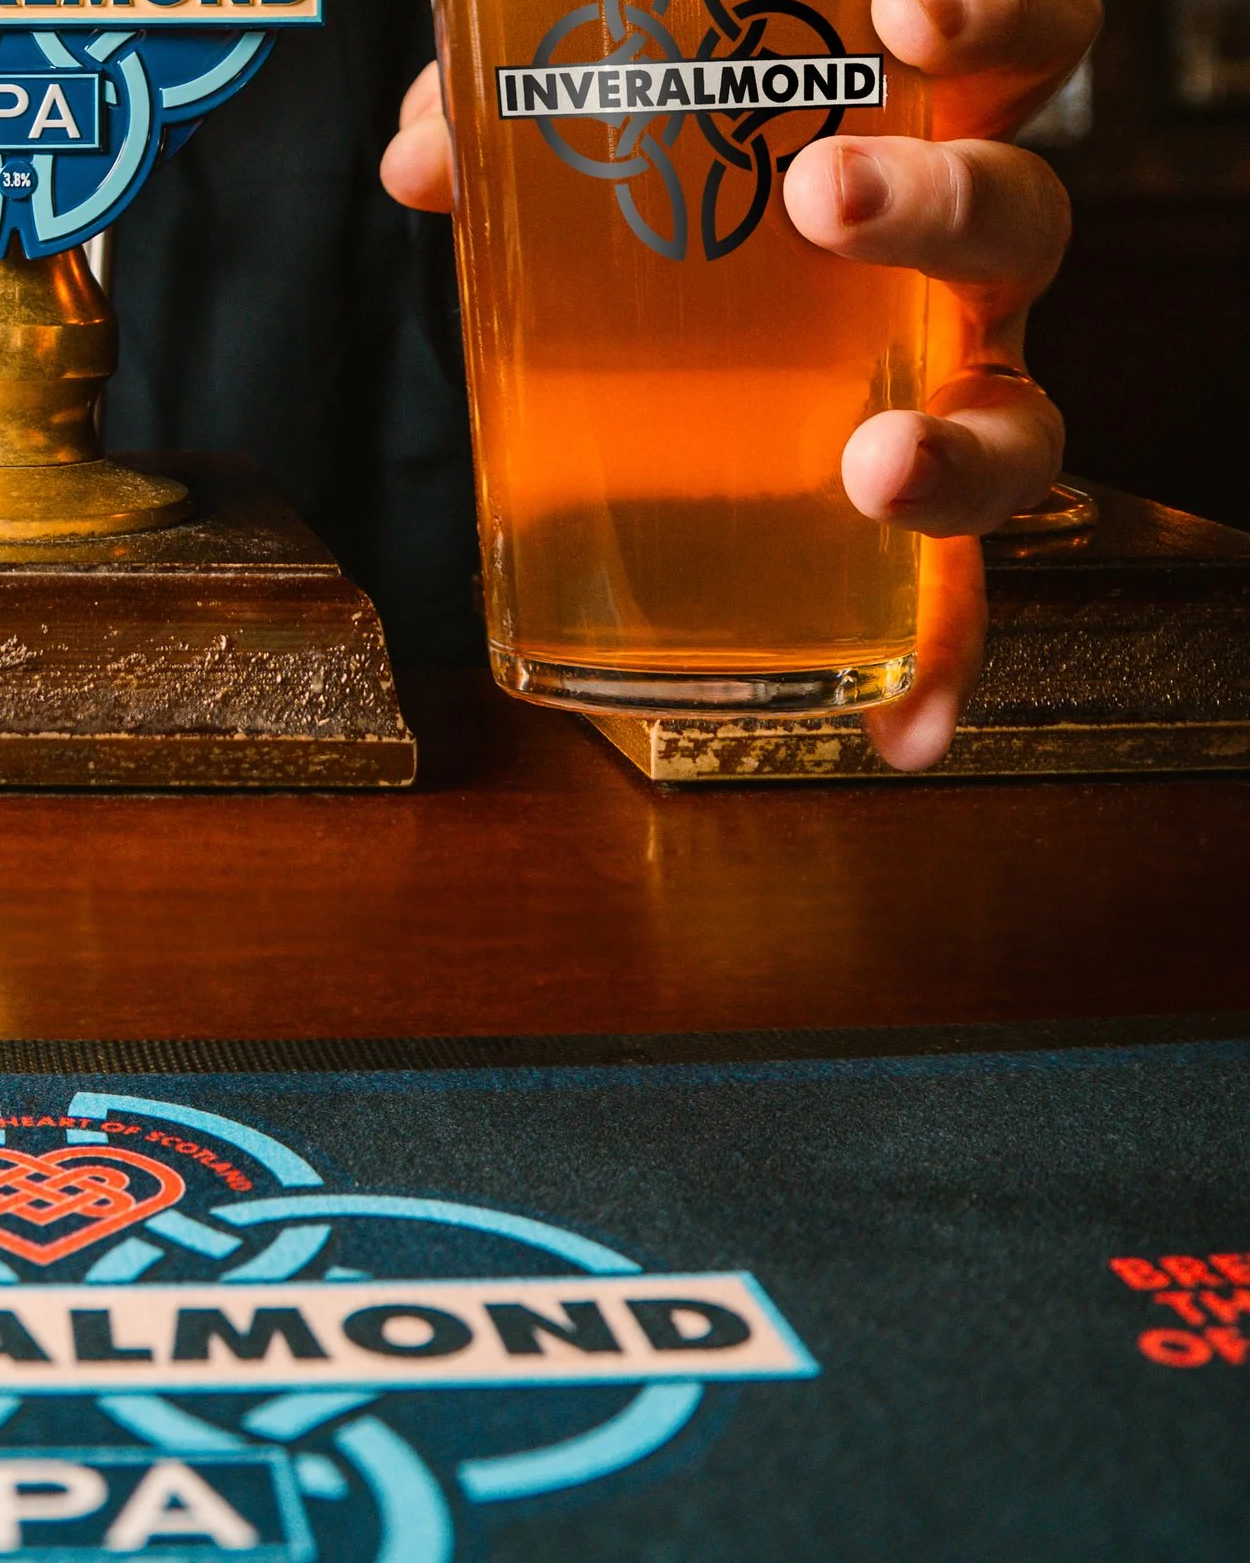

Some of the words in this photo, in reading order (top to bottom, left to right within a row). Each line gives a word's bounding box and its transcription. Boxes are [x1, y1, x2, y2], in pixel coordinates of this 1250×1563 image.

[504, 63, 877, 112] INVERALMOND
[2, 171, 31, 188] 3.8%
[100, 1121, 143, 1136] OF
[143, 1130, 253, 1193] SCOTLAND
